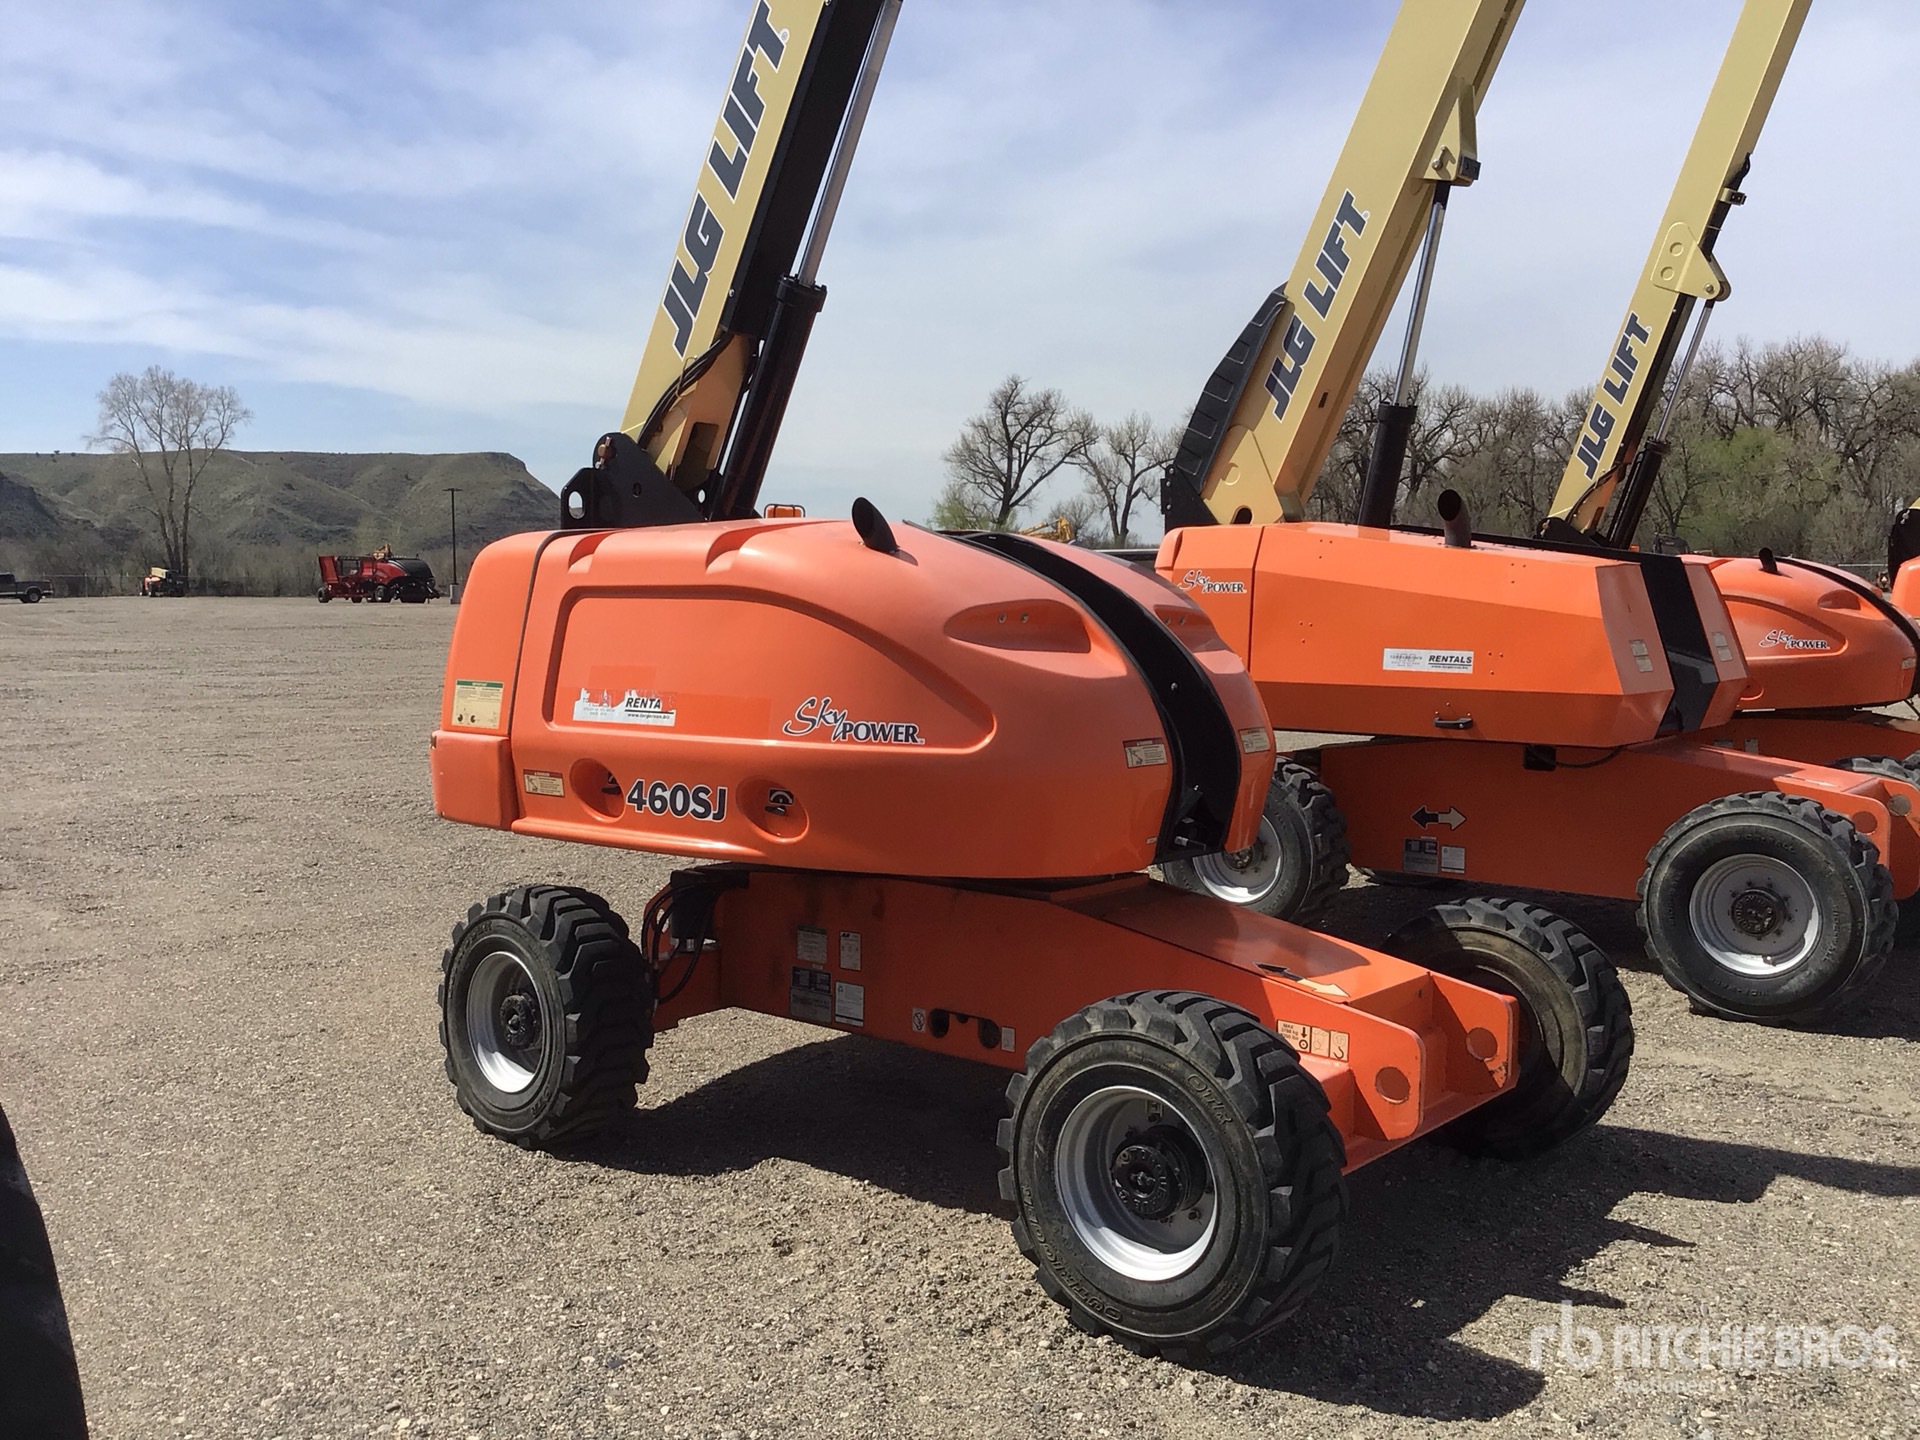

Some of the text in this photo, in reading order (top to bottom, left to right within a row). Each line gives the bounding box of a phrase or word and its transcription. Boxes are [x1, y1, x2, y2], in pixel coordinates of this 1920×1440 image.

[662, 0, 787, 361] JLG LIFT
[1264, 188, 1368, 423] JLG LIFT
[1576, 310, 1651, 481] JLG LIFT
[1428, 654, 1472, 664] RENTALS
[625, 778, 727, 823] 460SJ
